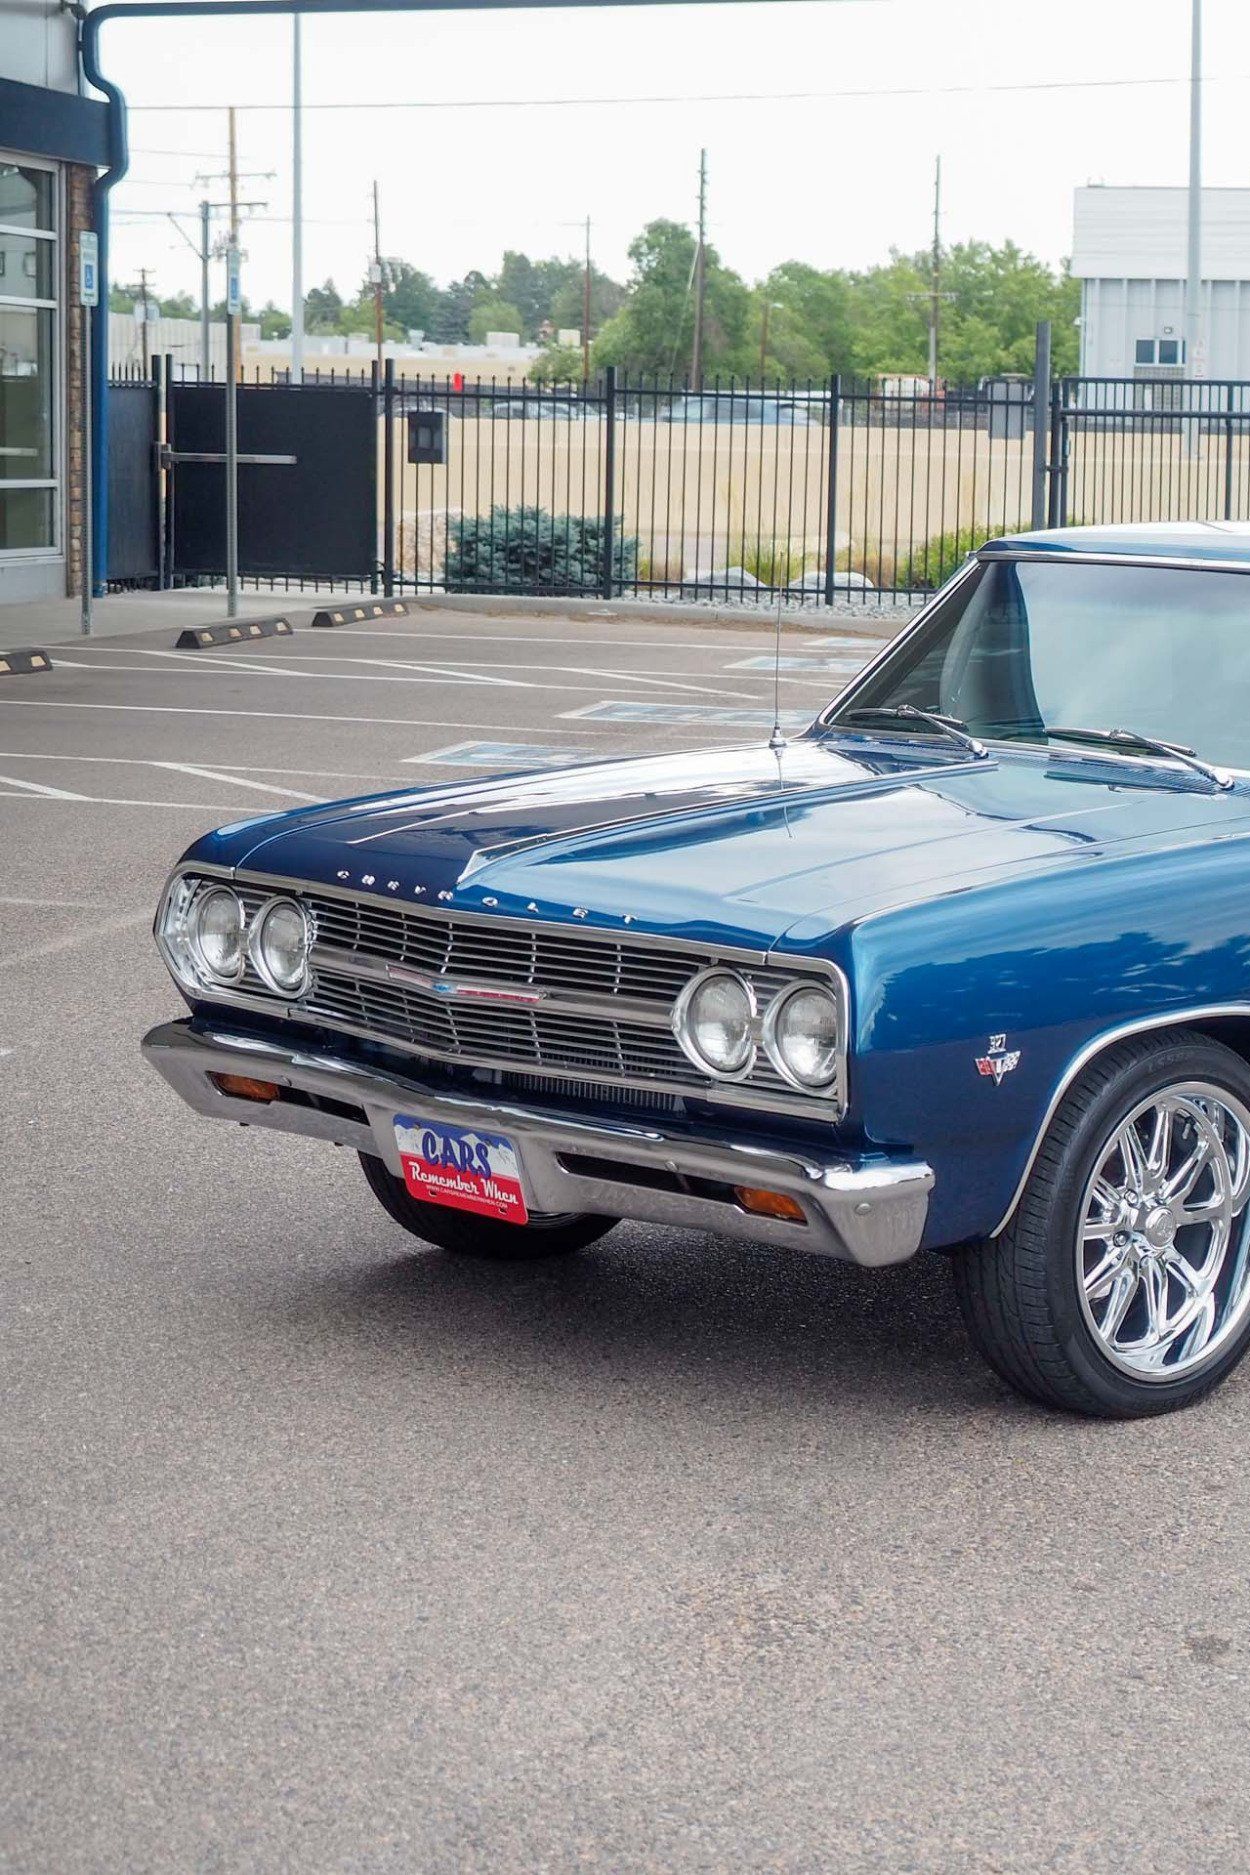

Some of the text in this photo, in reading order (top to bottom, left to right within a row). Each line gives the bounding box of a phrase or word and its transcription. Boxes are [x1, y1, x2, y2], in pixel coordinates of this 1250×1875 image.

[337, 869, 637, 924] CHEVROLET
[422, 1131, 491, 1180] CARS
[409, 1161, 519, 1205] Remember When
